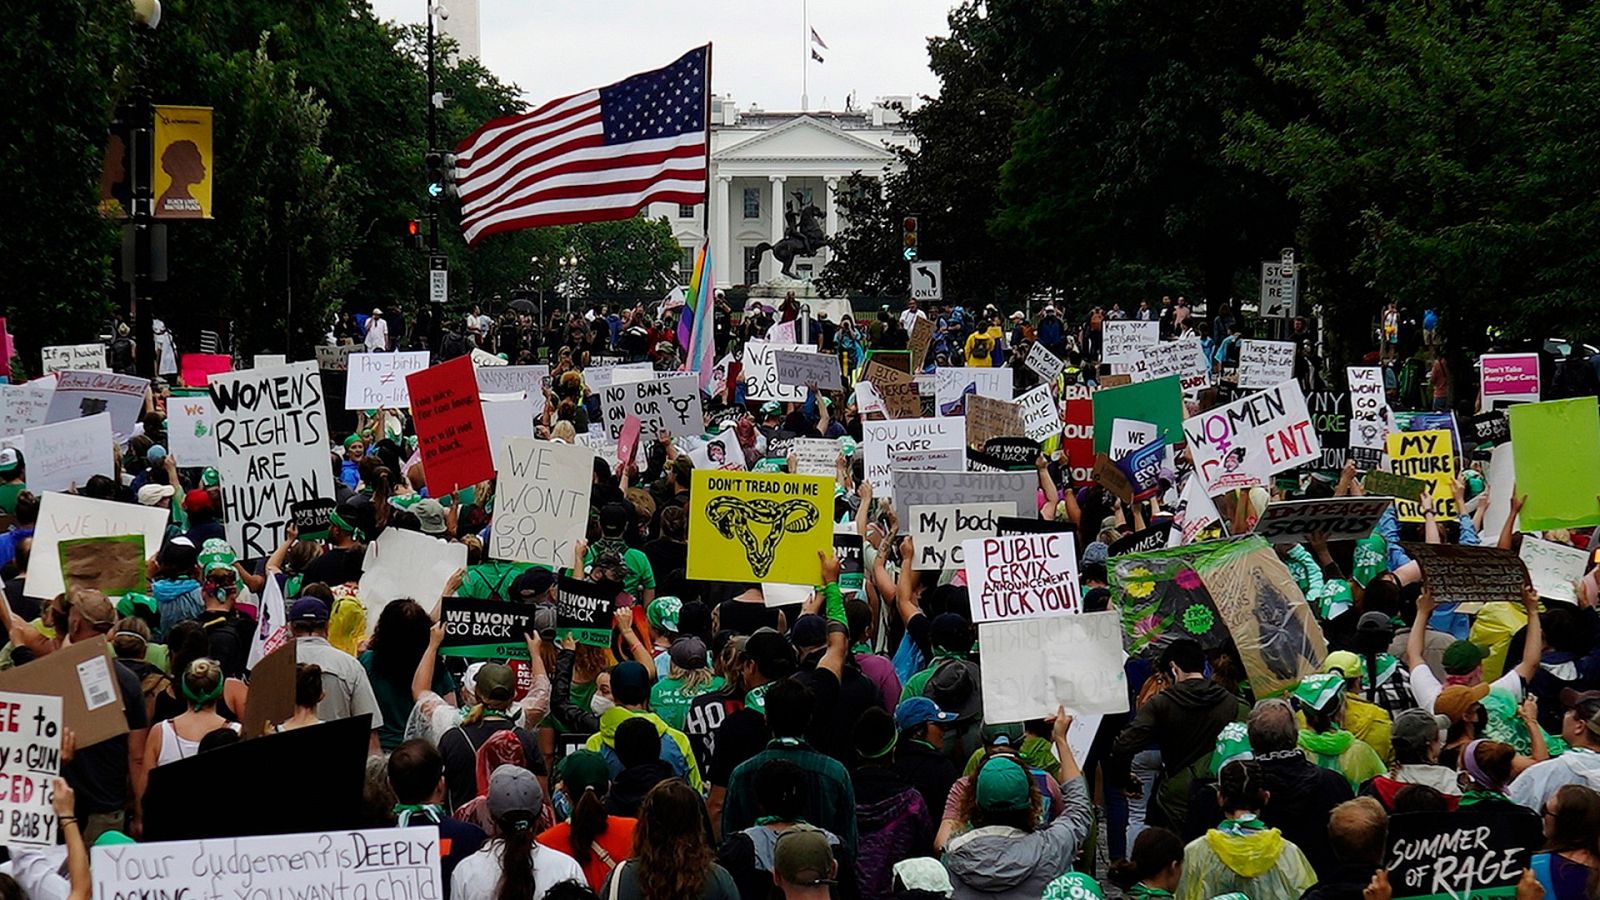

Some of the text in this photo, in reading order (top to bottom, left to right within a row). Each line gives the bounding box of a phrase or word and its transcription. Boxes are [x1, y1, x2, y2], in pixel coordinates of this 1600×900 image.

[915, 289, 937, 297] ONLY
[1269, 288, 1282, 297] RE
[1180, 375, 1207, 390] BABY
[1352, 369, 1374, 381] WE
[208, 371, 321, 414] WOMENS
[606, 382, 671, 403] NO BANS
[745, 377, 803, 398] BACK
[609, 401, 661, 420] ON OUR
[1357, 398, 1377, 408] GO
[215, 410, 321, 457] RIGHTS
[866, 423, 947, 442] YOU WILL
[1127, 431, 1145, 445] WE
[1400, 435, 1437, 456] MY
[247, 452, 290, 483] ARE
[508, 444, 552, 481] WE
[1390, 454, 1451, 476] FUTURE
[222, 469, 319, 523] HUMAN
[708, 478, 818, 496] DON'T TREAD ON ME
[500, 482, 585, 518] WONT
[1267, 500, 1387, 519] IMPEACH
[294, 508, 315, 519] WE
[295, 516, 313, 526] GO
[494, 513, 537, 537] GO
[919, 511, 947, 542] My
[1264, 516, 1375, 537] SCOTUS
[241, 520, 288, 560] RI
[496, 536, 569, 566] BACK
[833, 546, 860, 558] N'T
[922, 546, 947, 568] My
[983, 535, 1060, 568] PUBLIC
[987, 560, 1051, 583] CERVIX
[982, 571, 1070, 596] ANNOUNCEMENT
[568, 593, 610, 612] WON'T
[981, 581, 1080, 619] FUCK YOU!
[446, 610, 529, 627] WE WON'T
[566, 605, 594, 623] BACK
[446, 622, 511, 637] GO BACK
[33, 706, 58, 738] to
[14, 743, 58, 771] a GUN
[9, 809, 55, 841] BABY
[103, 847, 174, 882] Your
[349, 832, 435, 870] DEEPLY
[1386, 826, 1491, 872] SUMMER
[1405, 847, 1526, 900] OF RAGE
[374, 872, 440, 900] child
